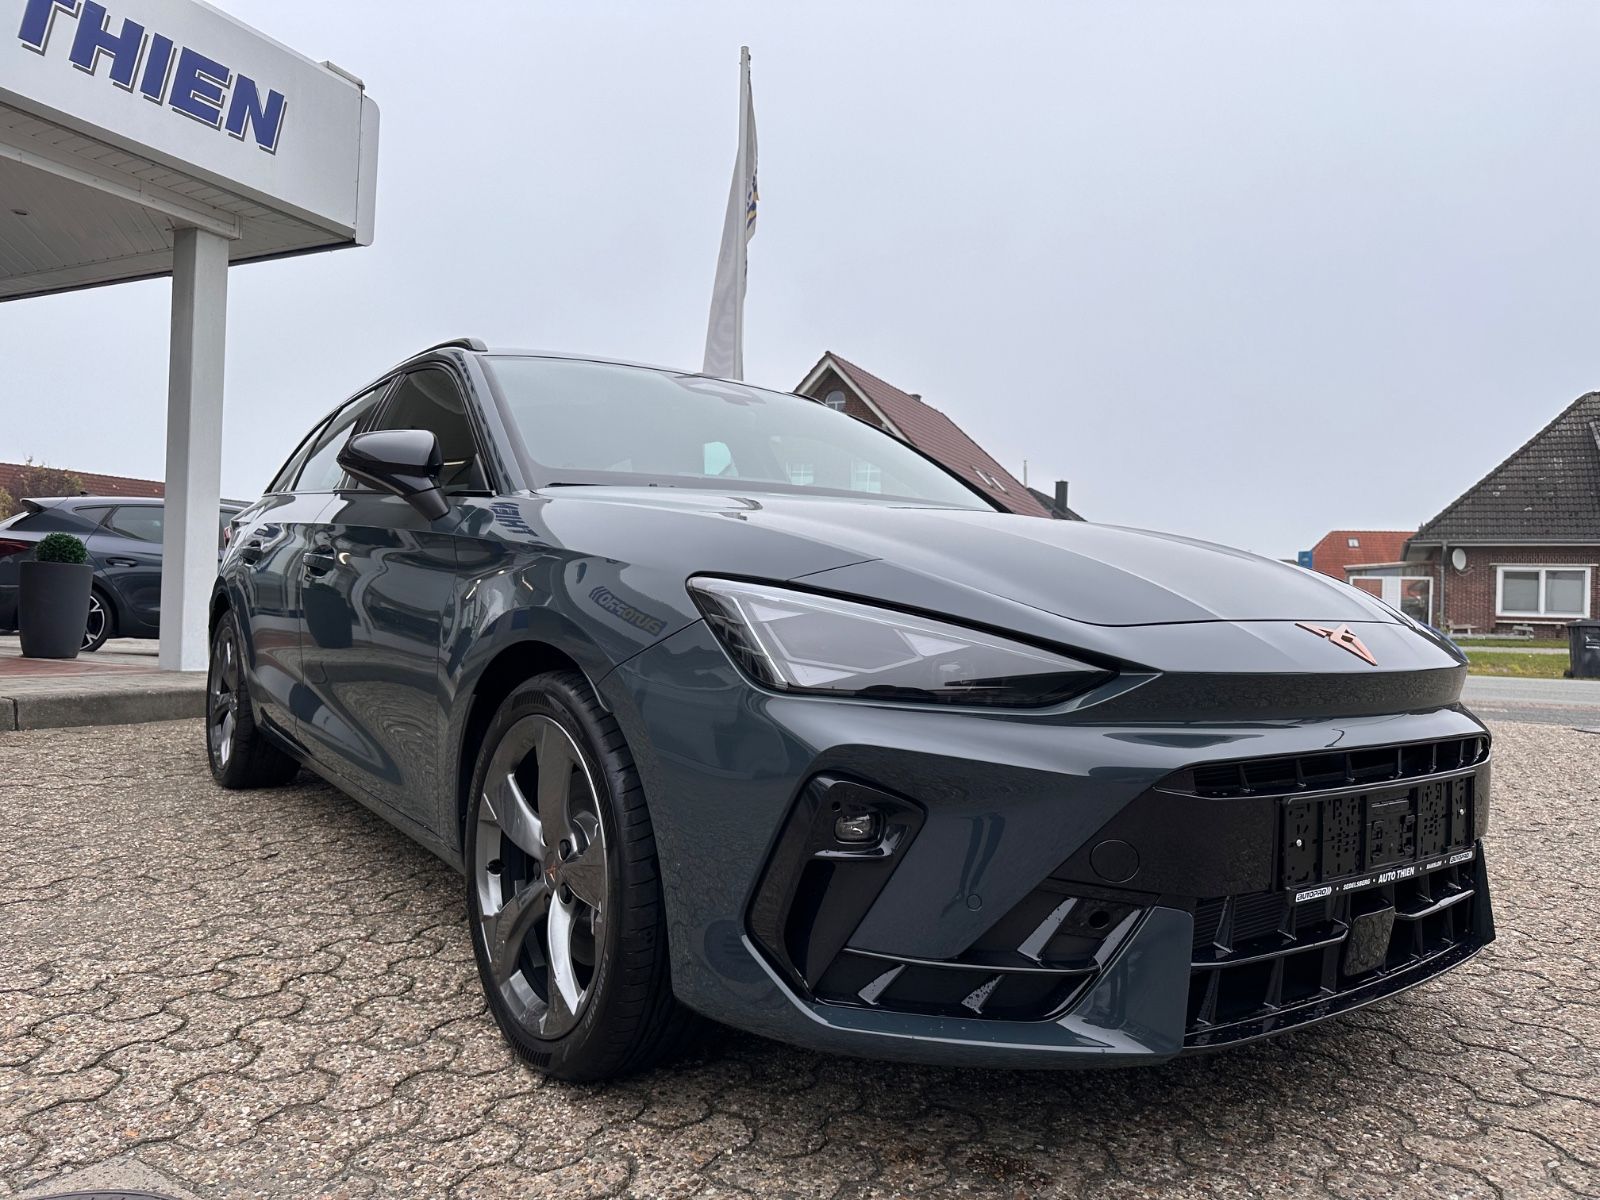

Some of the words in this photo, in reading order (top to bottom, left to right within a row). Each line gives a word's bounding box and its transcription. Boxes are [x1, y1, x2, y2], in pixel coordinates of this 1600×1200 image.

[17, 0, 288, 155] THIEN
[1377, 870, 1396, 884] AUTO
[1396, 866, 1415, 879] THIEN
